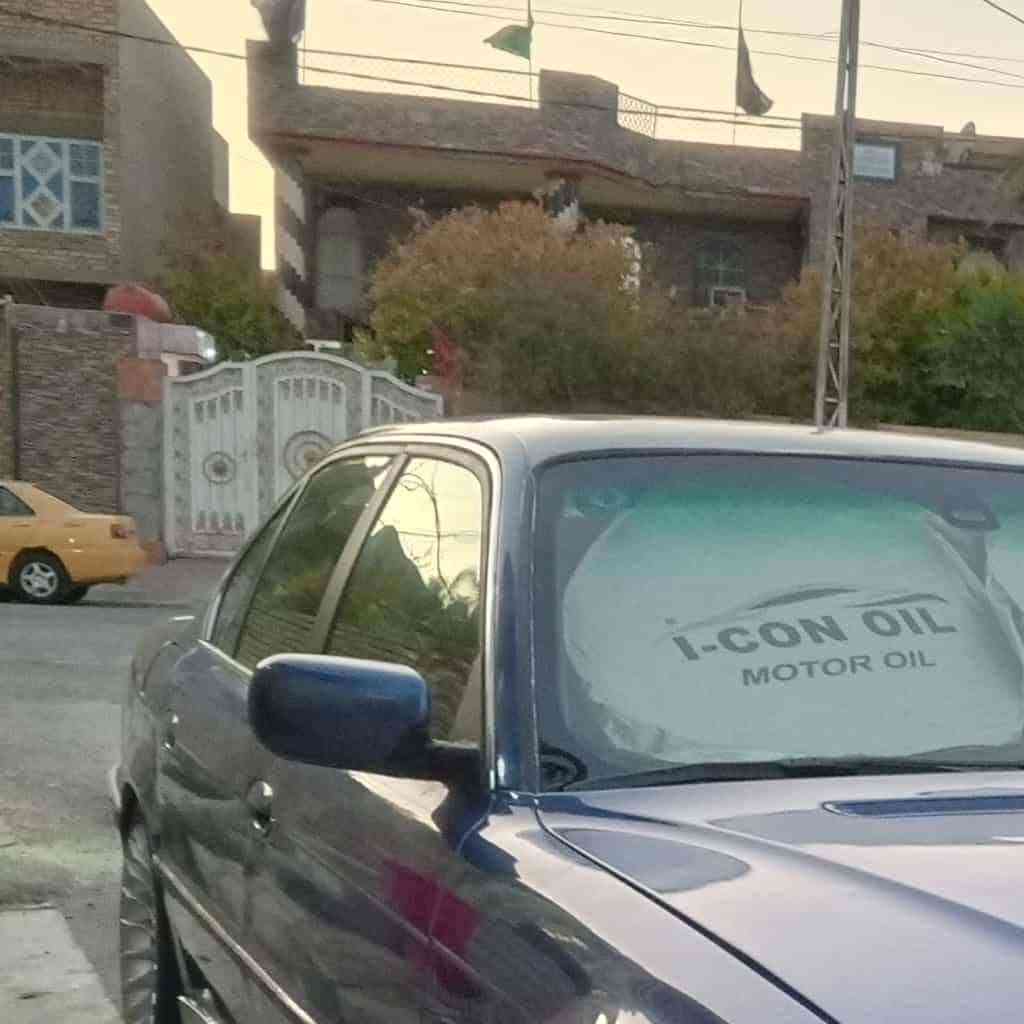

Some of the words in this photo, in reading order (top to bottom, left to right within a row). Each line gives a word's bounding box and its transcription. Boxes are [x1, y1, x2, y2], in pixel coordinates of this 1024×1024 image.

[861, 607, 957, 637] OIL
[742, 655, 873, 686] MOTOR
[883, 649, 936, 669] OIL
